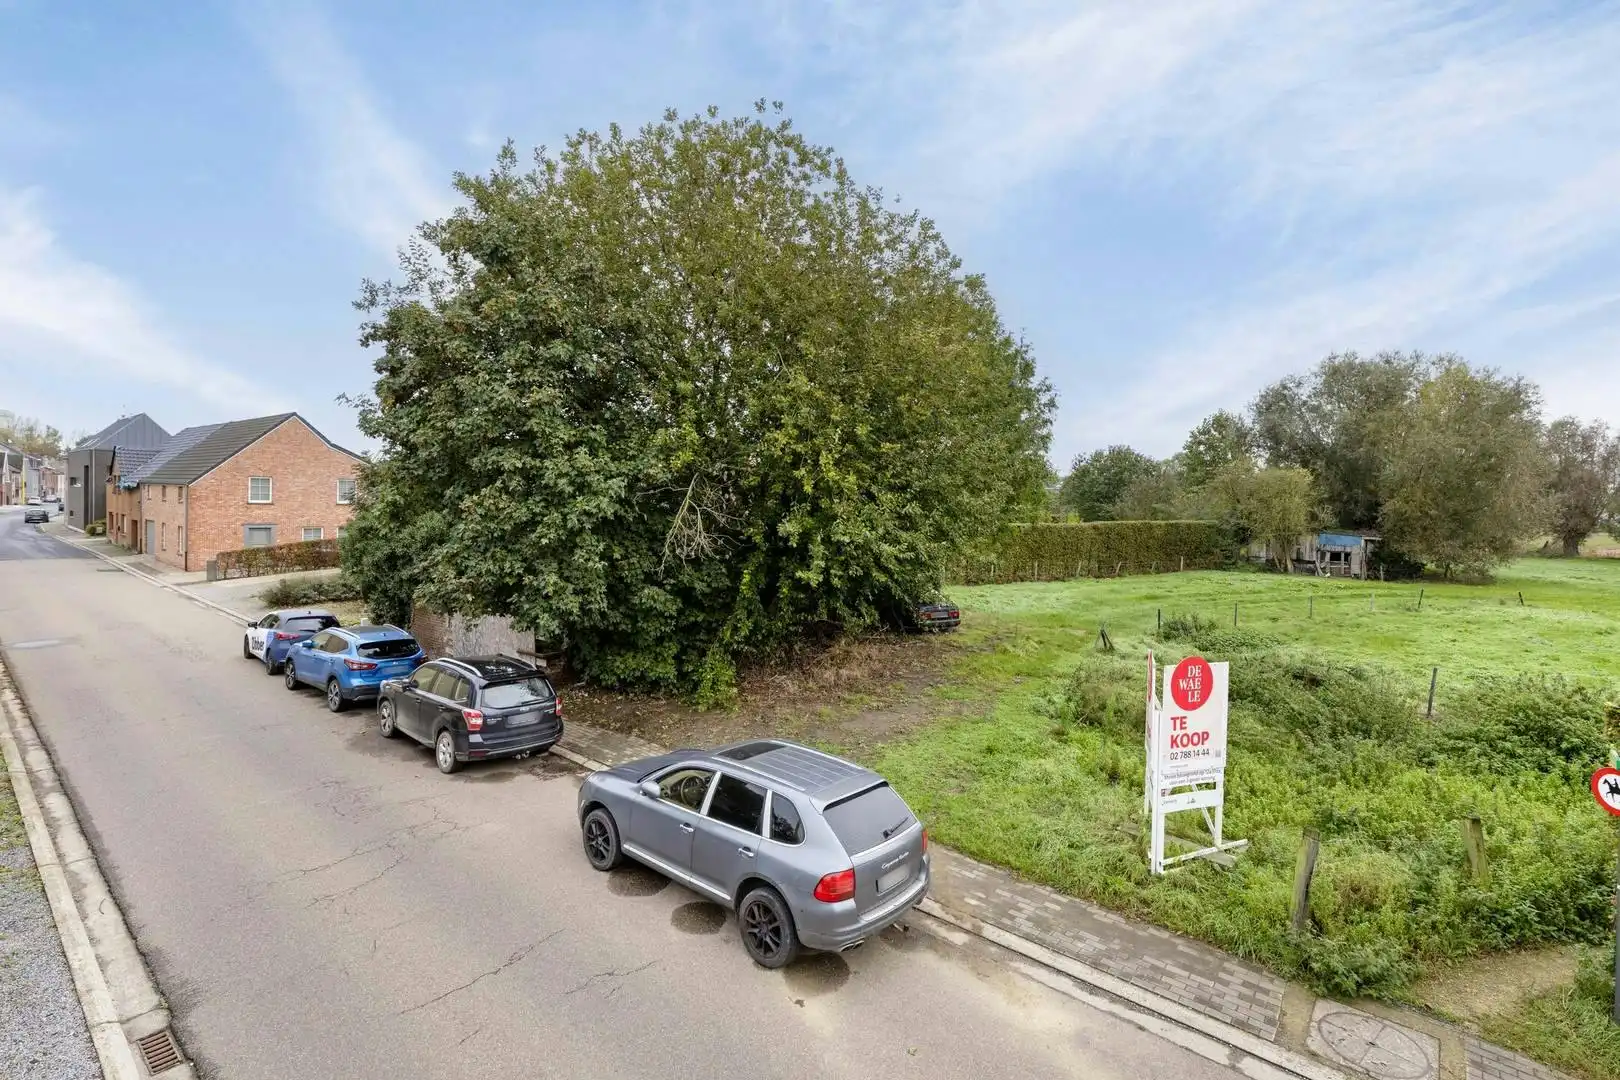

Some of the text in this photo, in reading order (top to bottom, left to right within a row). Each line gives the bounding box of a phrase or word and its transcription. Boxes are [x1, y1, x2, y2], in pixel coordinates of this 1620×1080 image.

[1188, 665, 1202, 677] DE
[1179, 678, 1202, 690] WAE
[1188, 691, 1201, 702] LE
[1170, 716, 1187, 731] TE
[1170, 731, 1209, 749] KOOP
[1170, 748, 1209, 760] 02 788 14 44
